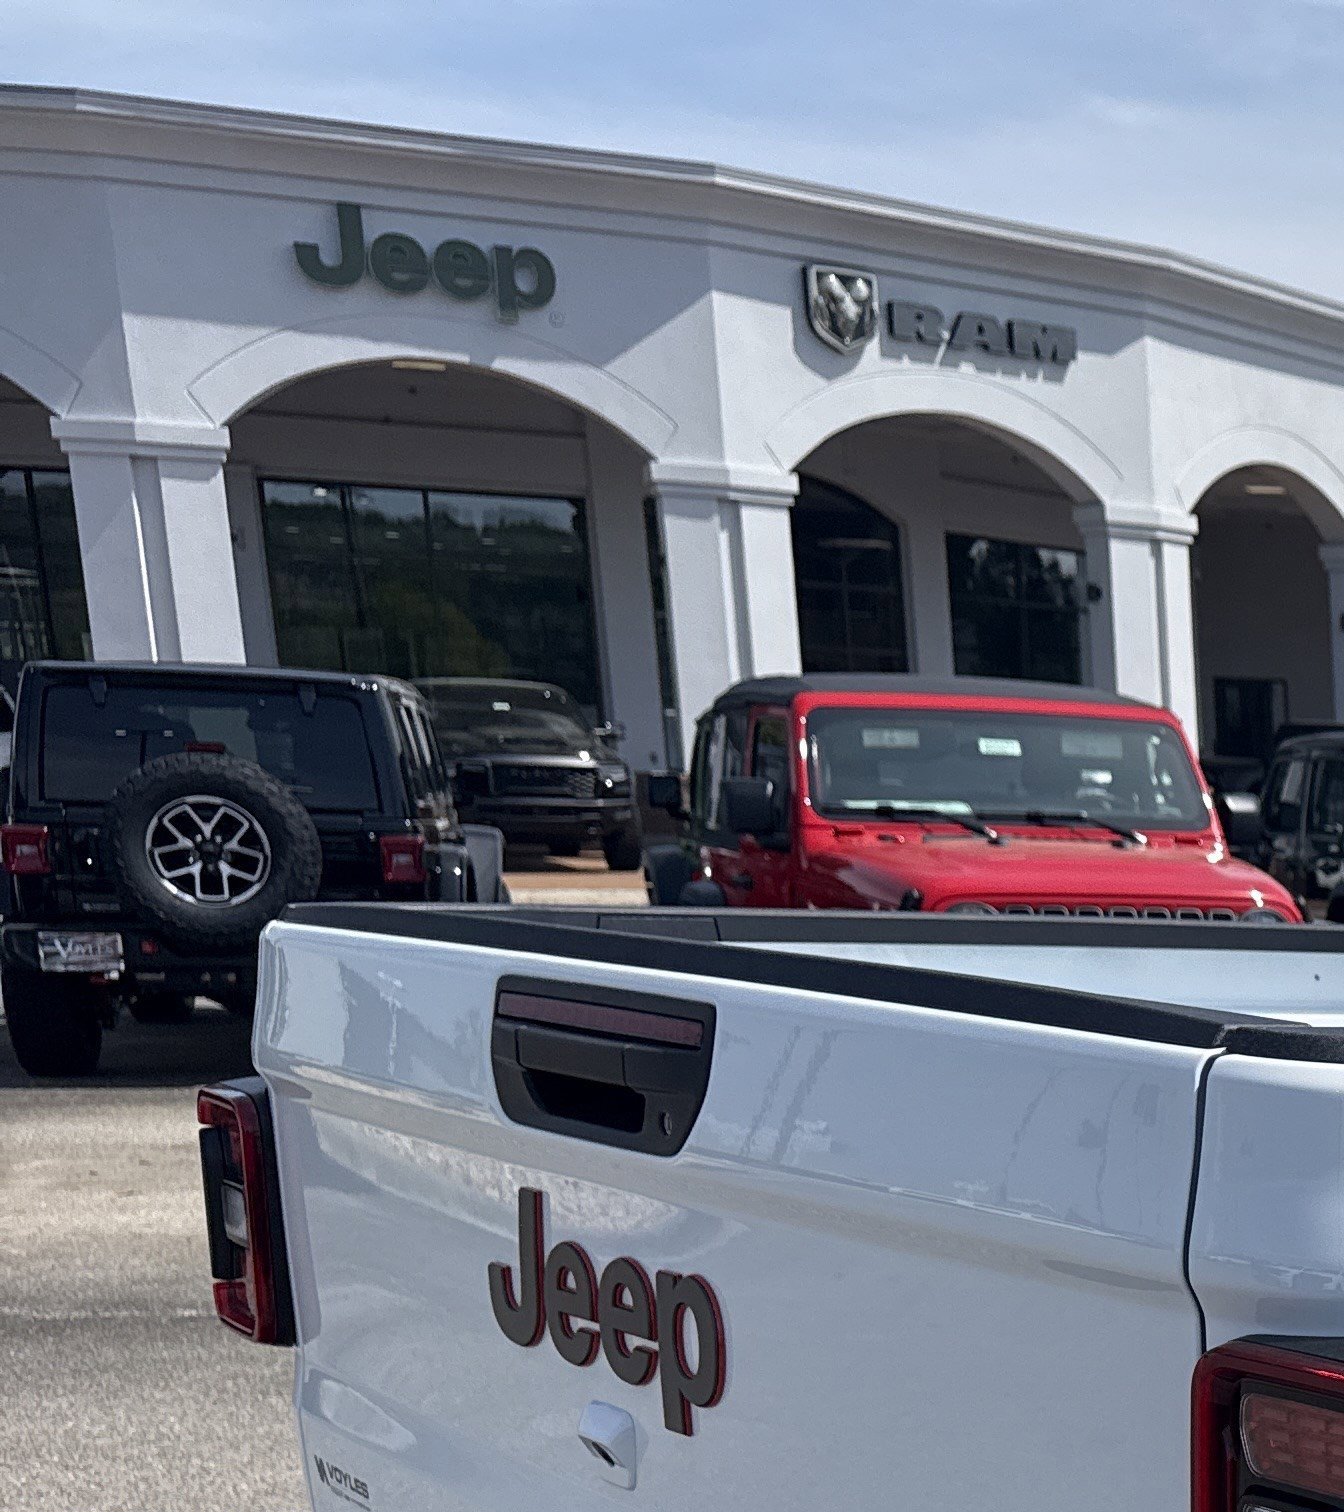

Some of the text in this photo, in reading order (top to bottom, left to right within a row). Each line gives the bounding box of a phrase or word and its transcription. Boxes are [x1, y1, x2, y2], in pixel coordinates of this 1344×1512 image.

[294, 203, 556, 322] Jeep
[887, 298, 1077, 365] RAM
[488, 1187, 727, 1436] Jeep
[326, 1462, 369, 1499] VOYLES
